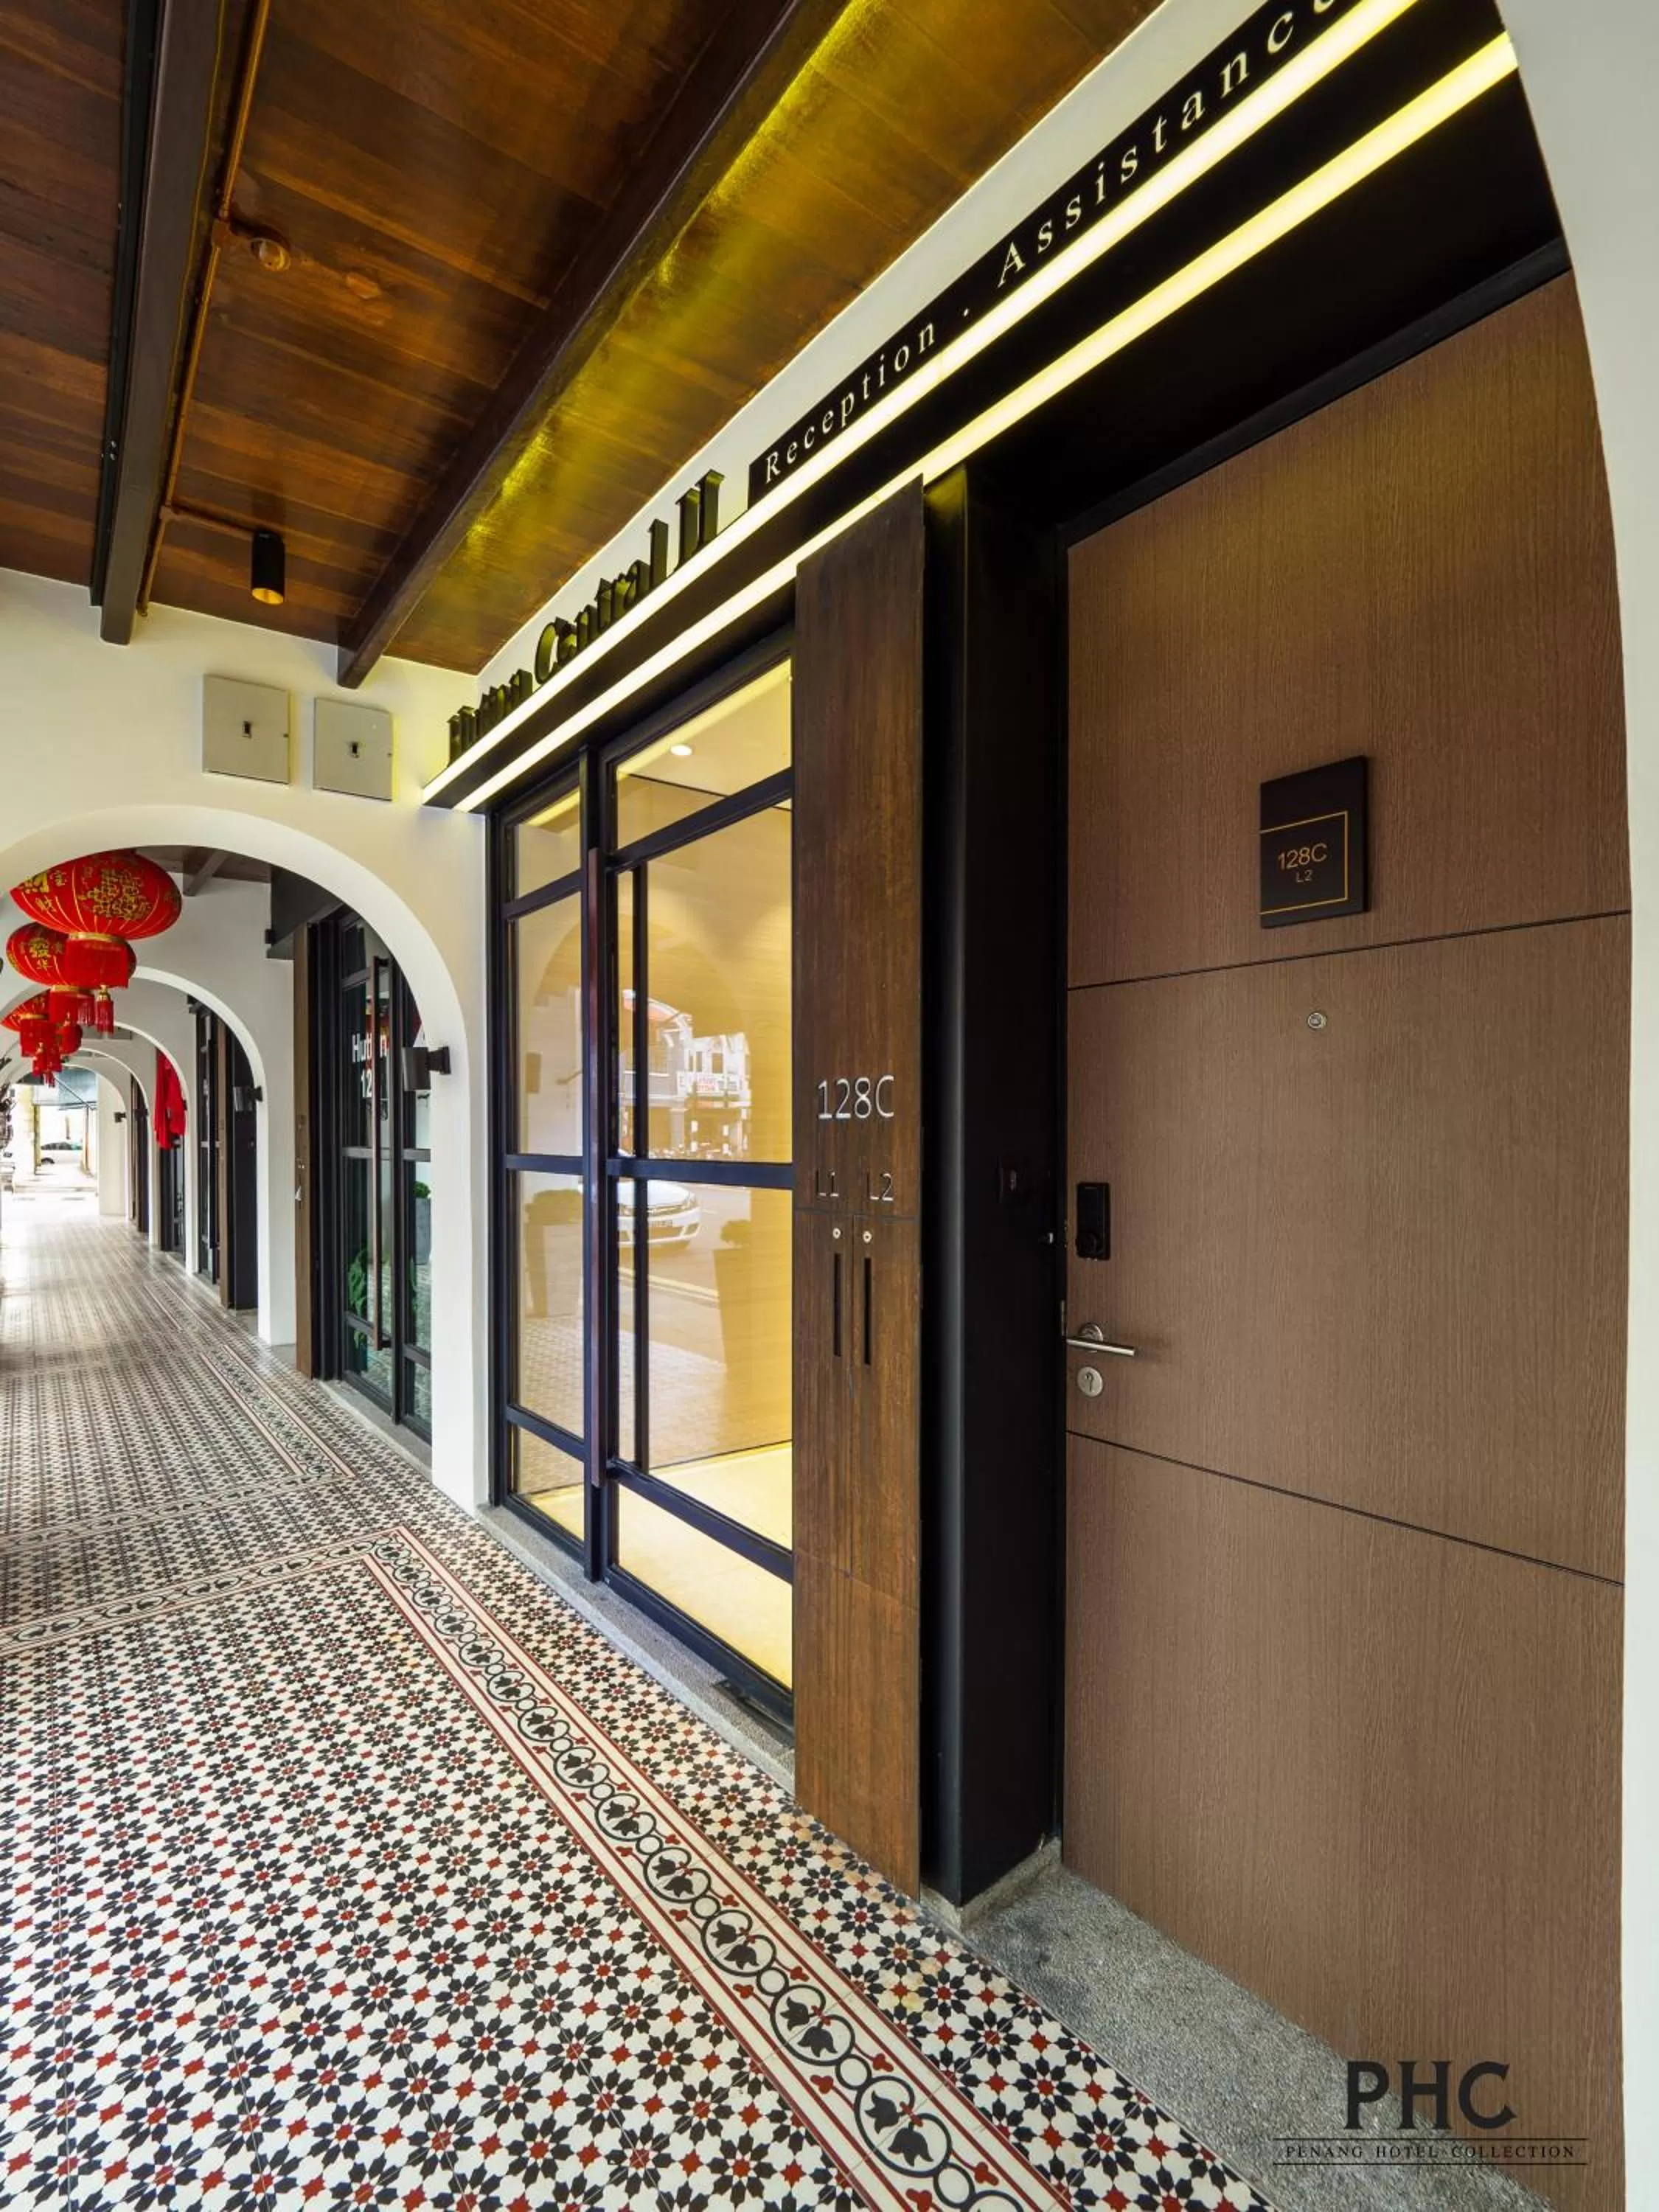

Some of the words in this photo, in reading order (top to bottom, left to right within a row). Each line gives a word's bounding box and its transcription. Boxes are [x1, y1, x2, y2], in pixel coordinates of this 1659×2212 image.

[765, 321, 936, 484] Reception
[1278, 843, 1328, 870] 128C
[1296, 870, 1312, 883] L2
[818, 1075, 894, 1119] 128C
[866, 1172, 894, 1202] L2
